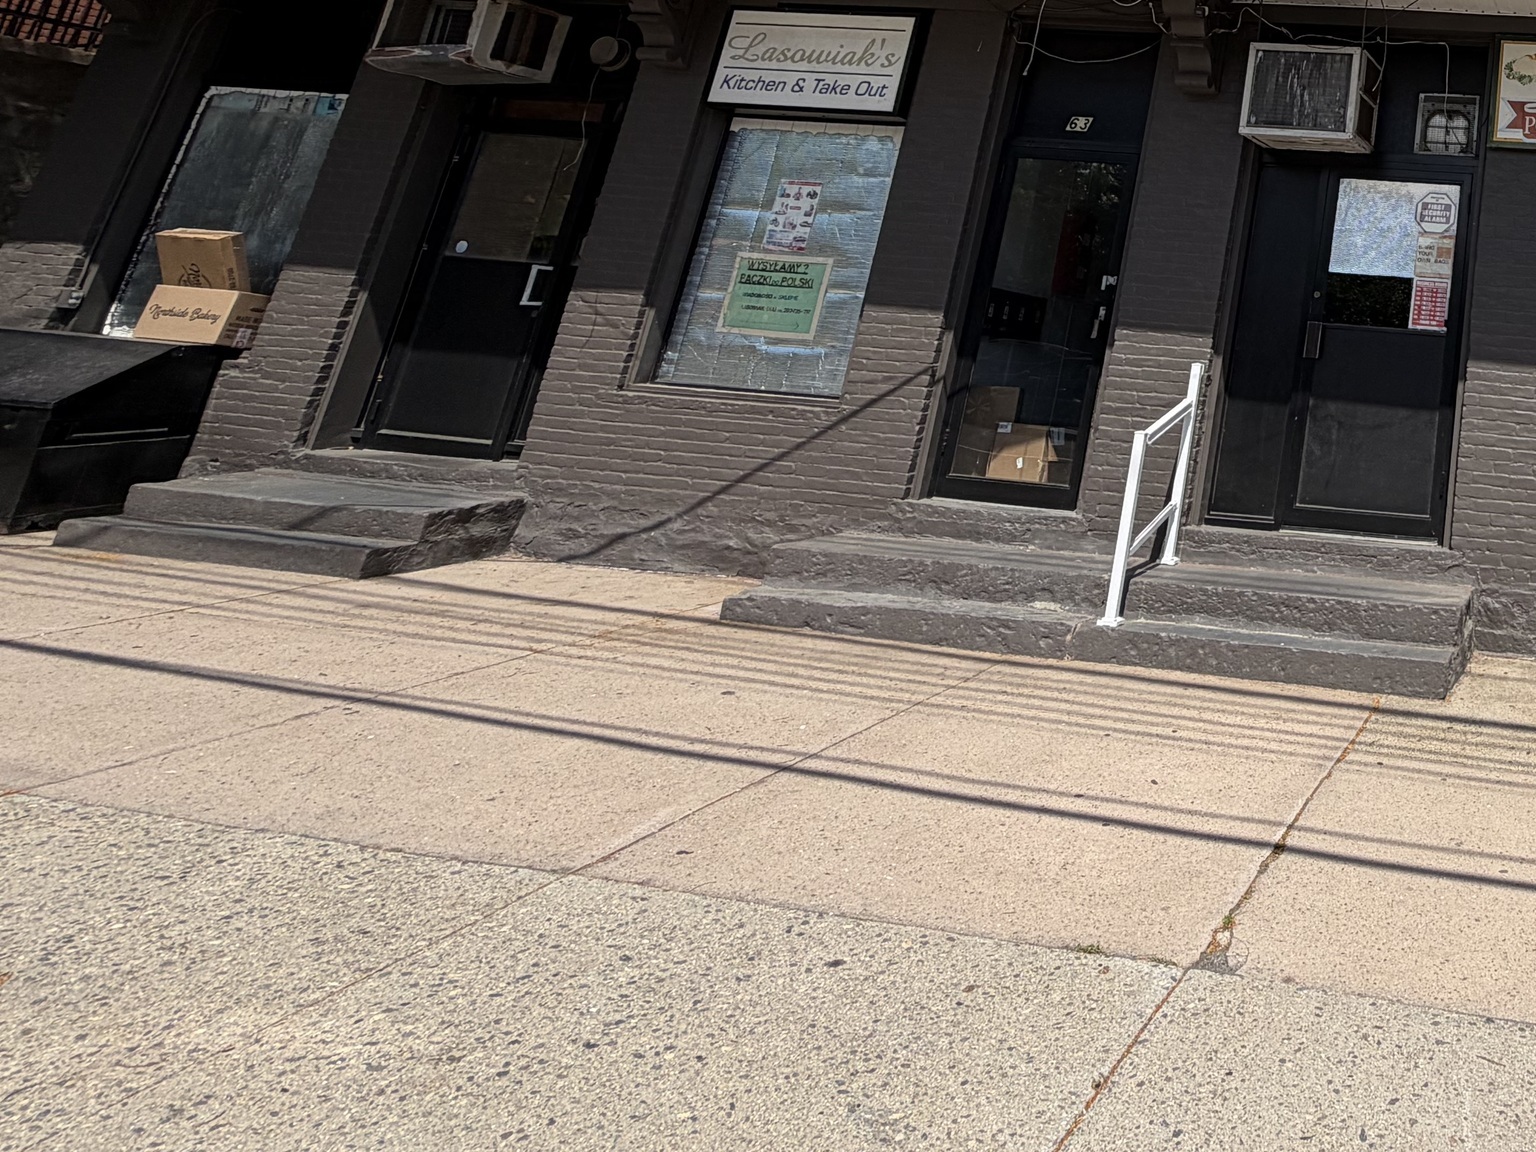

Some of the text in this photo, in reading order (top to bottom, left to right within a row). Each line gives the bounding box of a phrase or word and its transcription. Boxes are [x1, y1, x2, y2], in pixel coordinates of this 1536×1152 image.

[728, 32, 901, 68] Lasowiak's
[720, 74, 888, 97] Kitchen & Take Out
[1069, 117, 1090, 130] 63
[780, 277, 814, 288] POLSKI
[148, 304, 221, 325] Northside Bakery
